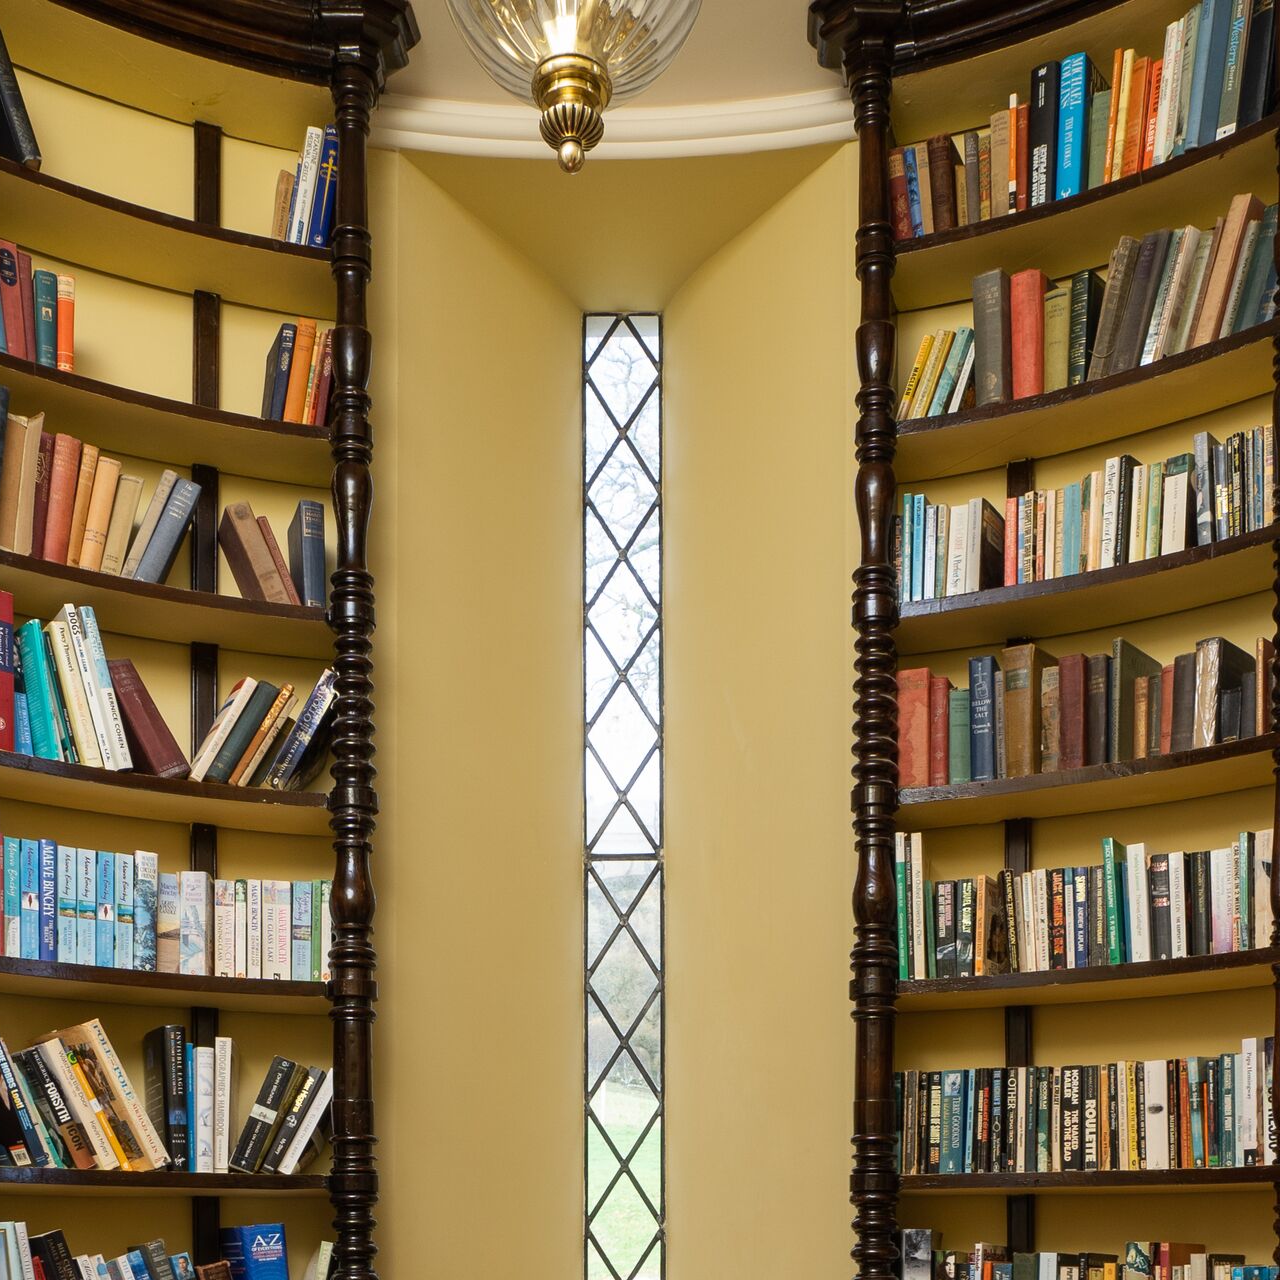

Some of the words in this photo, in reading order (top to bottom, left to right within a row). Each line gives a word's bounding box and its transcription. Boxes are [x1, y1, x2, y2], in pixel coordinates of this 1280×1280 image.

[1146, 118, 1155, 153] RABBLE
[107, 692, 120, 720] BERNICE
[114, 720, 125, 749] COHEN
[43, 844, 55, 879] MAEVE
[43, 879, 55, 919] BINCHY
[1, 1062, 17, 1089] HOBBS
[32, 1049, 50, 1083] FREDERICK
[45, 1082, 71, 1123] FORSYTH
[66, 1123, 85, 1152] ICON
[1085, 1100, 1097, 1163] ROULETTE
